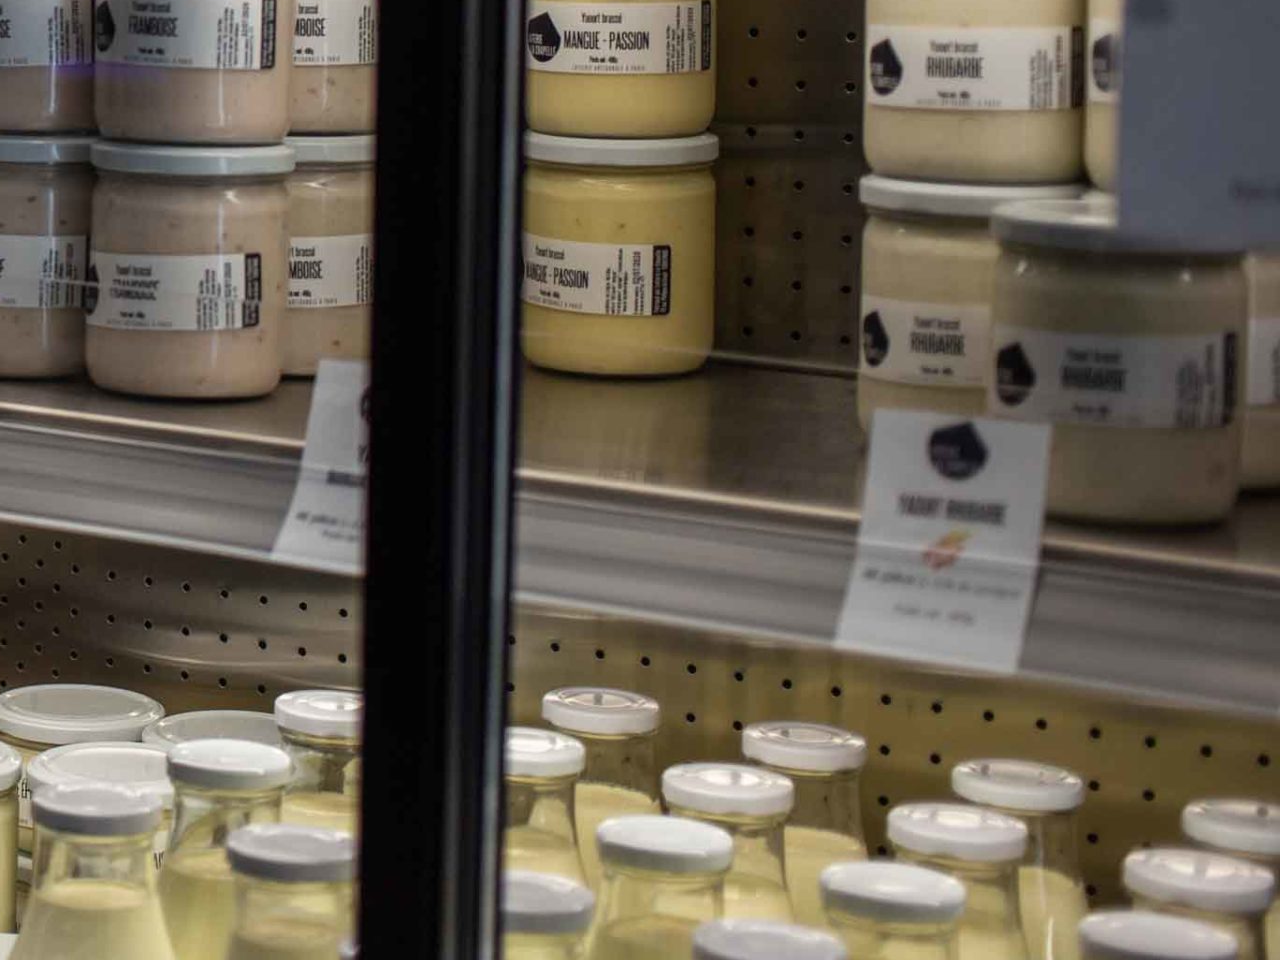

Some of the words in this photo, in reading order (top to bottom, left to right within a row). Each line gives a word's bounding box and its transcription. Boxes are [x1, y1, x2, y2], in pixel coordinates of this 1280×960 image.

[128, 17, 178, 38] FRAMBOISE
[563, 30, 600, 50] MANGUE
[608, 31, 650, 51] PASSION
[925, 57, 984, 80] RHUBARBE
[553, 268, 589, 290] PASSION
